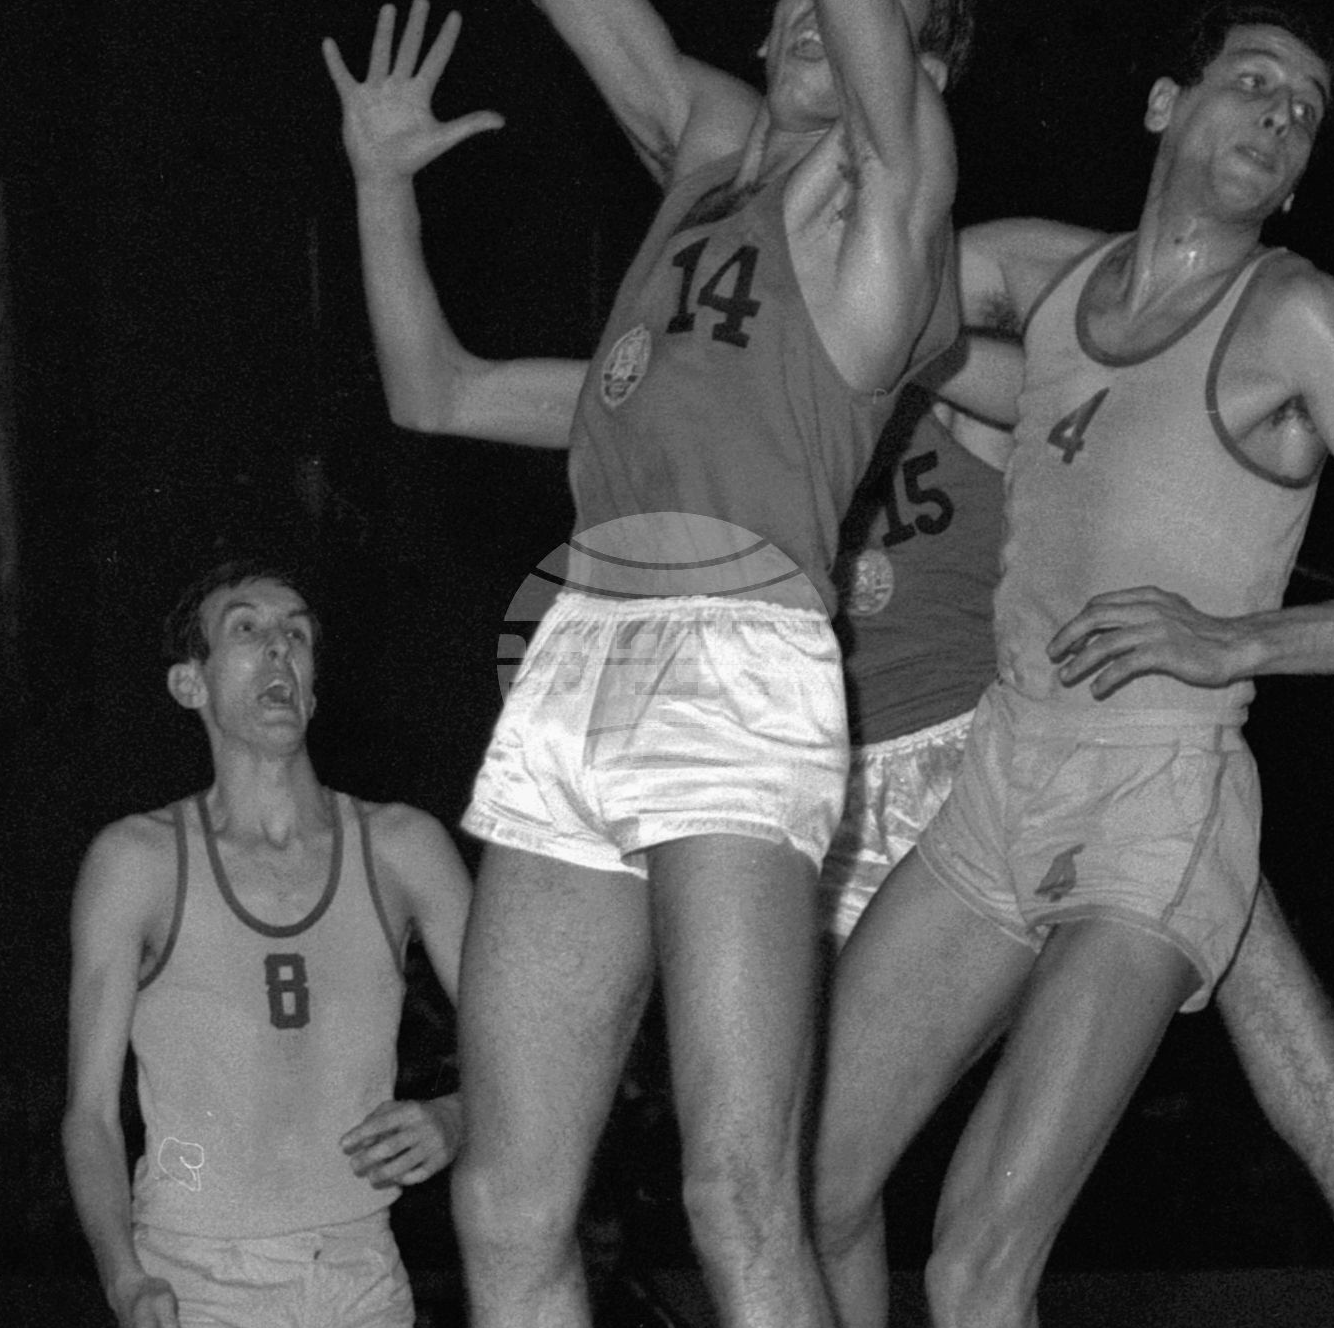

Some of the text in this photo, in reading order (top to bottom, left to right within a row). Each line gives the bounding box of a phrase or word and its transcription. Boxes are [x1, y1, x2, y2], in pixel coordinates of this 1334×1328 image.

[666, 236, 761, 349] 14
[1047, 386, 1110, 464] 4
[881, 449, 954, 548] 15
[264, 953, 310, 1029] 8
